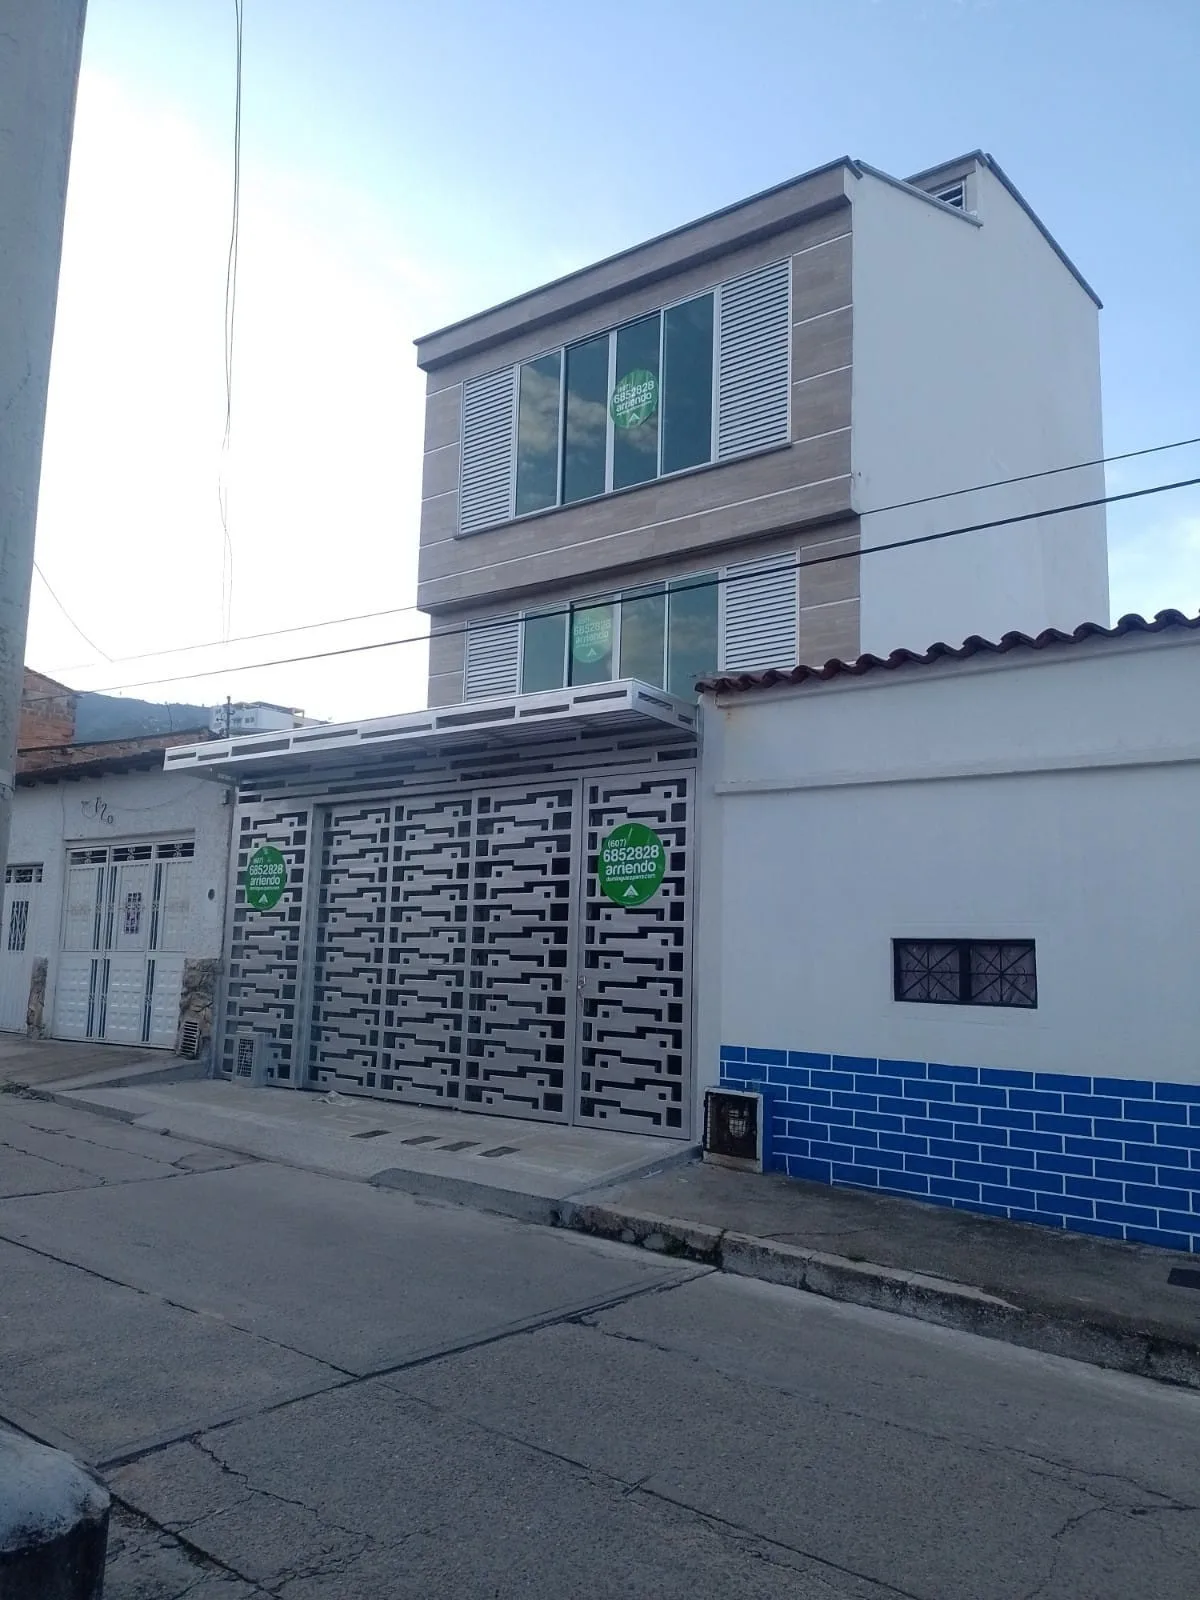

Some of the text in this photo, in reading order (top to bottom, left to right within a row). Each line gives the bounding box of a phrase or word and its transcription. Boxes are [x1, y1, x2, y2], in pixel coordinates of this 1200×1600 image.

[614, 380, 654, 403] 6852828
[608, 838, 627, 848] (607)
[603, 845, 659, 862] 6852828
[249, 863, 284, 876] 6852828
[605, 860, 657, 875] arriendo
[250, 875, 281, 886] arriendo
